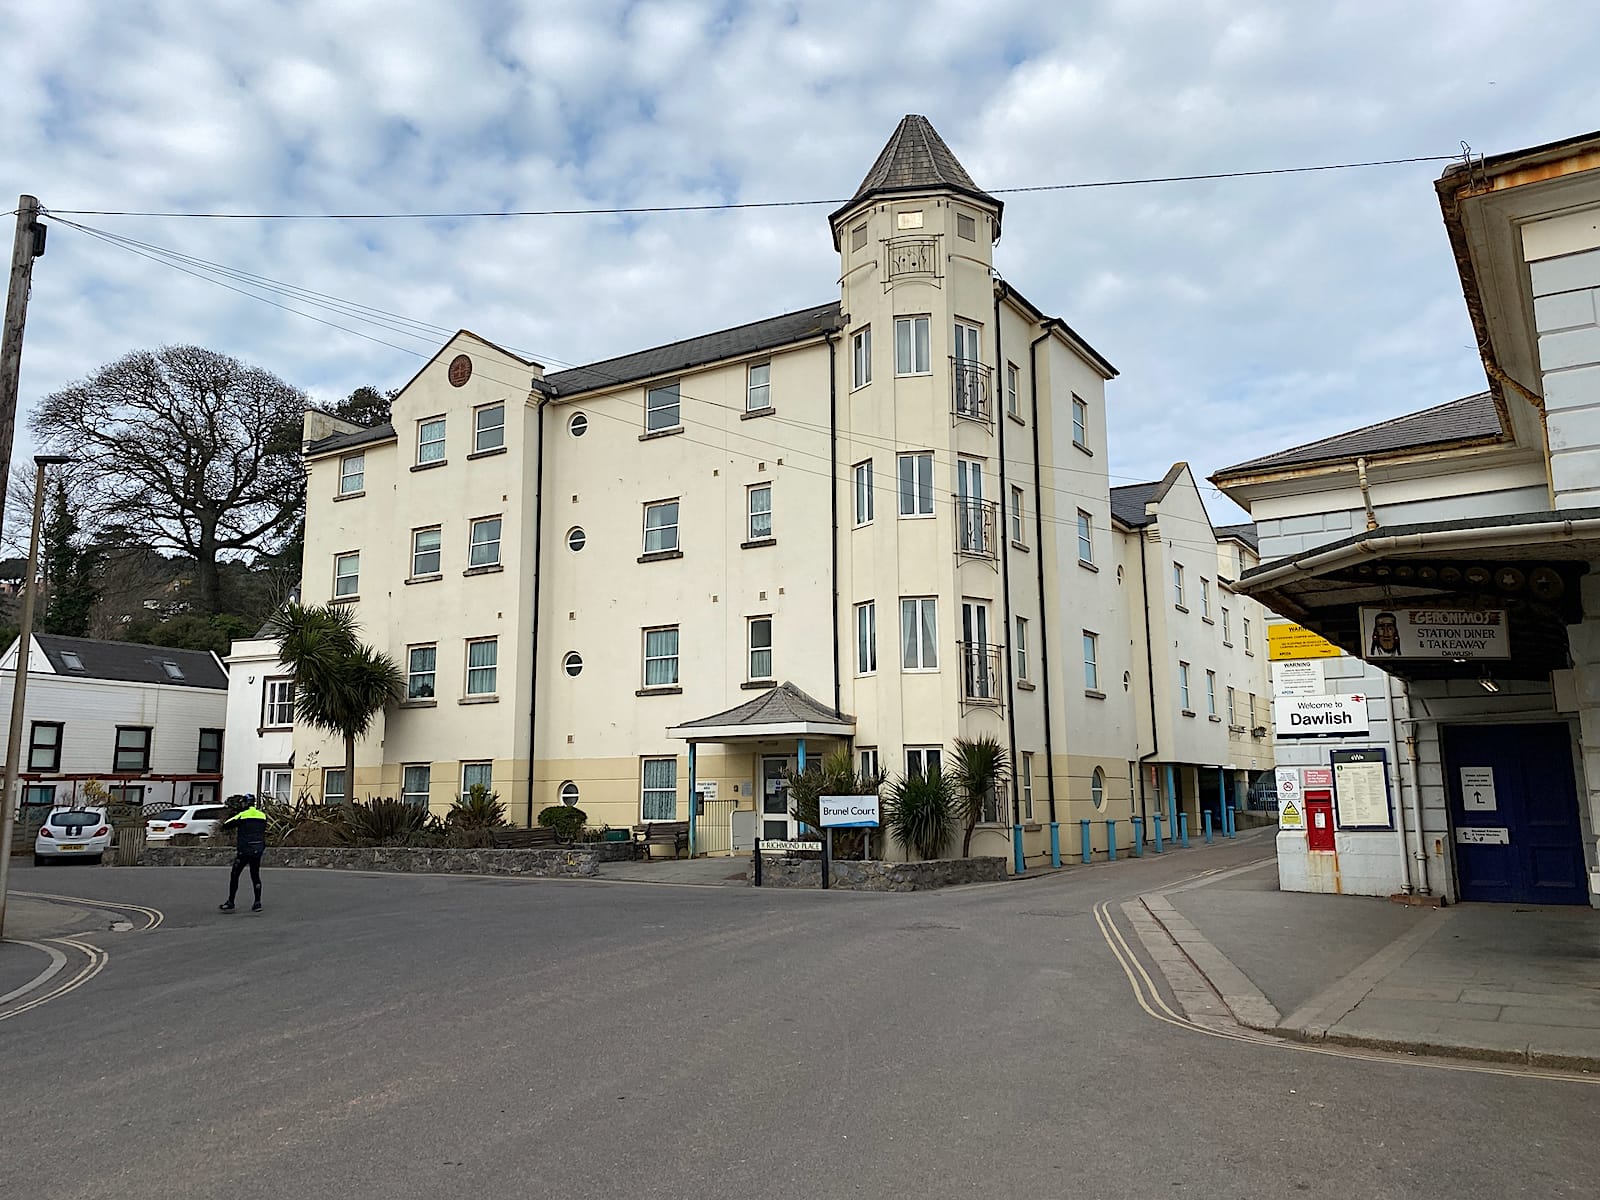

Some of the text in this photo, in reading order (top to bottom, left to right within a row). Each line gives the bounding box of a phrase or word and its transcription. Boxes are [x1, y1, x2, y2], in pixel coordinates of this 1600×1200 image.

[1415, 611, 1490, 624] GERONIMOS
[1417, 628, 1496, 639] STATION DINER
[1419, 639, 1488, 649] & TAKEAWAY
[1297, 702, 1333, 710] Welcome
[1290, 711, 1352, 726] Dawlish
[823, 806, 876, 816] Brunel Court
[766, 841, 820, 850] RICHMOND PLACE
